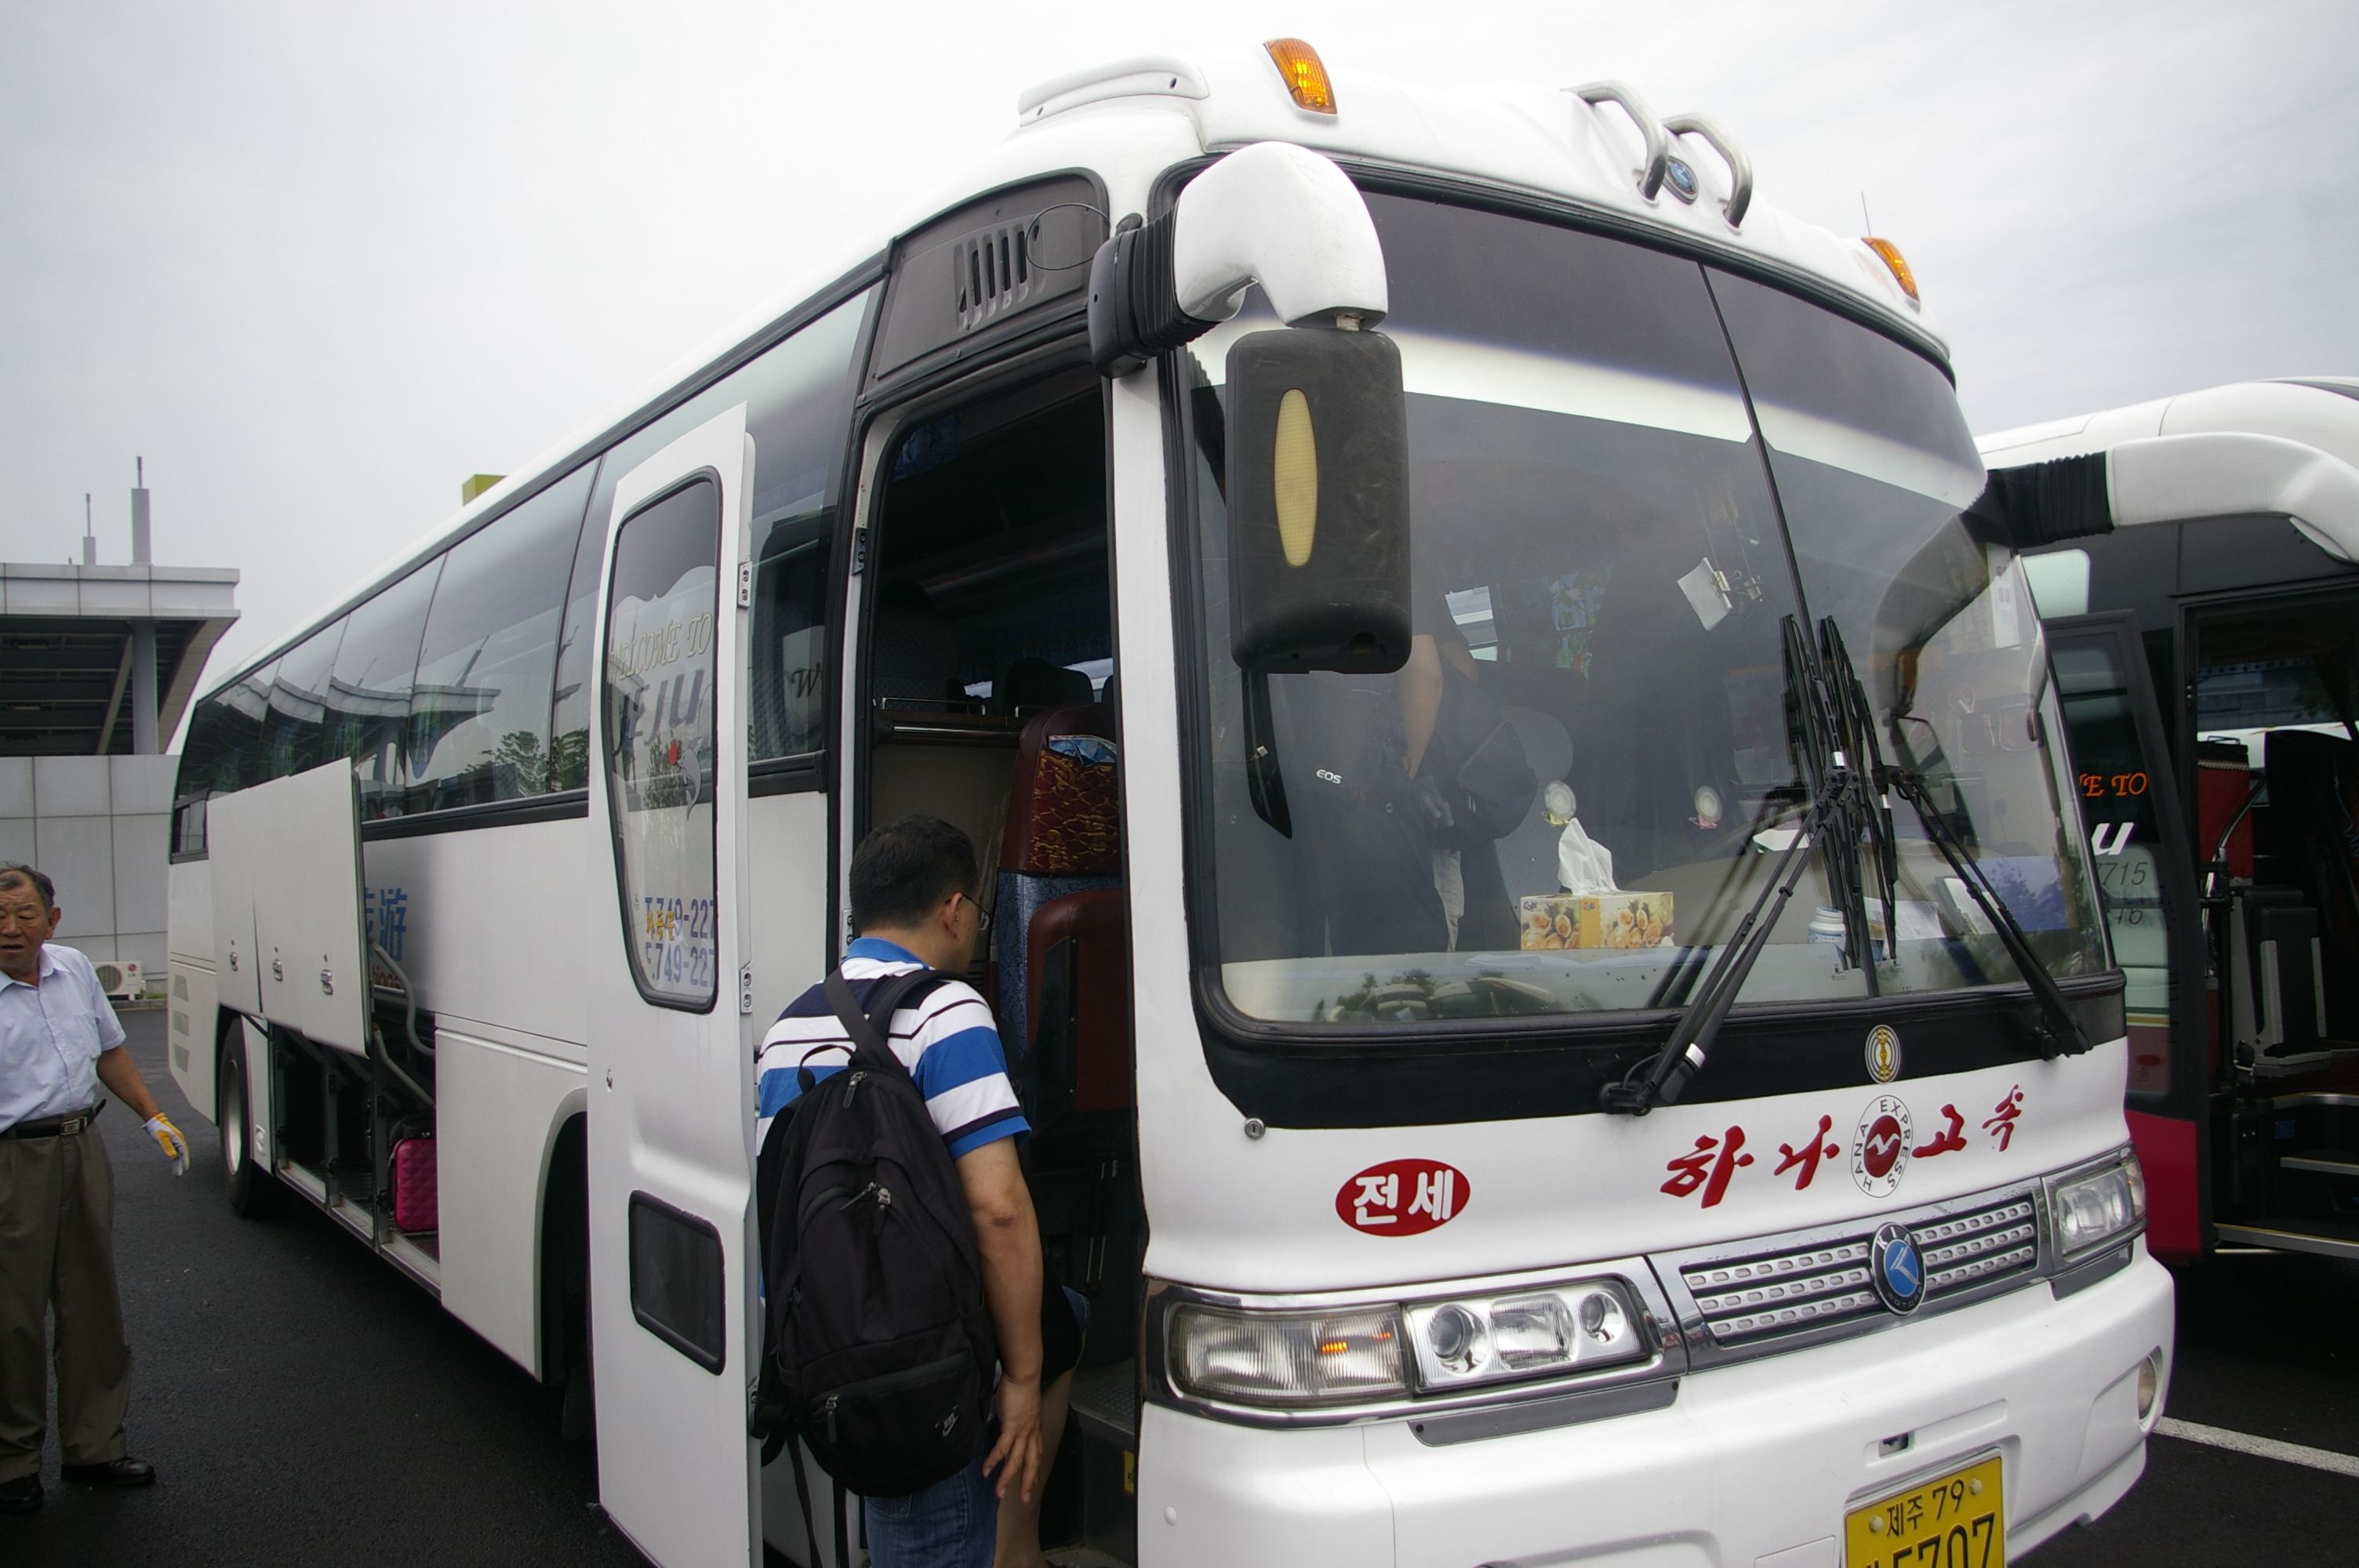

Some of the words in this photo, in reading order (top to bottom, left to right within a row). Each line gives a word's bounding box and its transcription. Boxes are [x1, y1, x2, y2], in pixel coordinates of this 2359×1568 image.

[607, 619, 682, 684] WELCOME
[687, 612, 713, 659] TO
[1316, 768, 1342, 784] EOS
[2080, 771, 2106, 797] E
[2110, 771, 2148, 797] TO
[1853, 1123, 1873, 1192] HANA
[1879, 1099, 1912, 1188] EXPRESS
[1353, 1168, 1454, 1226] 전세
[1877, 1225, 1912, 1251] KIA
[1886, 1494, 1924, 1537] 제주
[1932, 1479, 1965, 1521] 79
